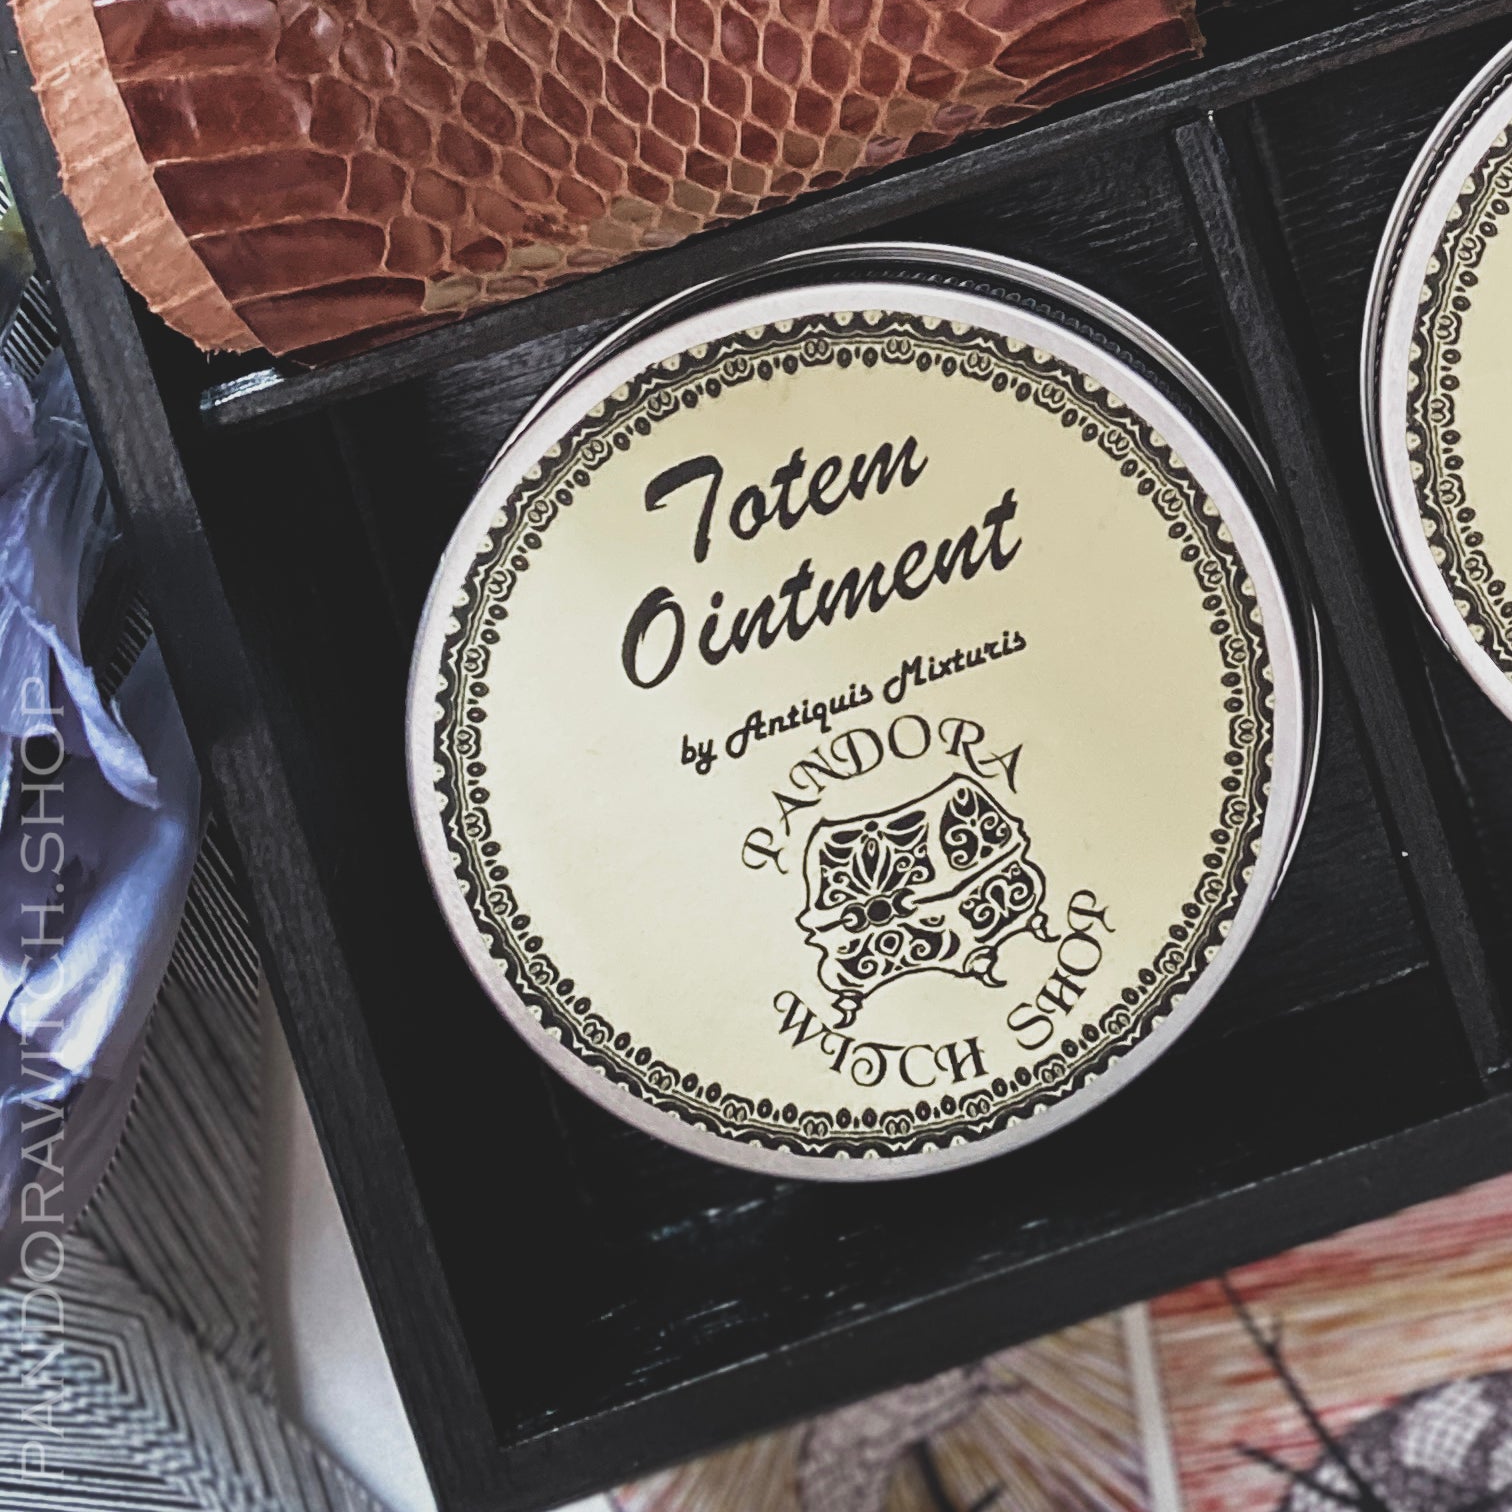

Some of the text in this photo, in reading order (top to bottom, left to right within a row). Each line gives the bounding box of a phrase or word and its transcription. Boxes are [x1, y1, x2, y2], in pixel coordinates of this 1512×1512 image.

[644, 434, 929, 563] Totem
[620, 489, 1023, 690] Ointment
[680, 631, 1028, 774] by Antiquis Mixturis
[741, 713, 1024, 875] PANDORA
[772, 888, 1117, 1088] WITCH SHOP
